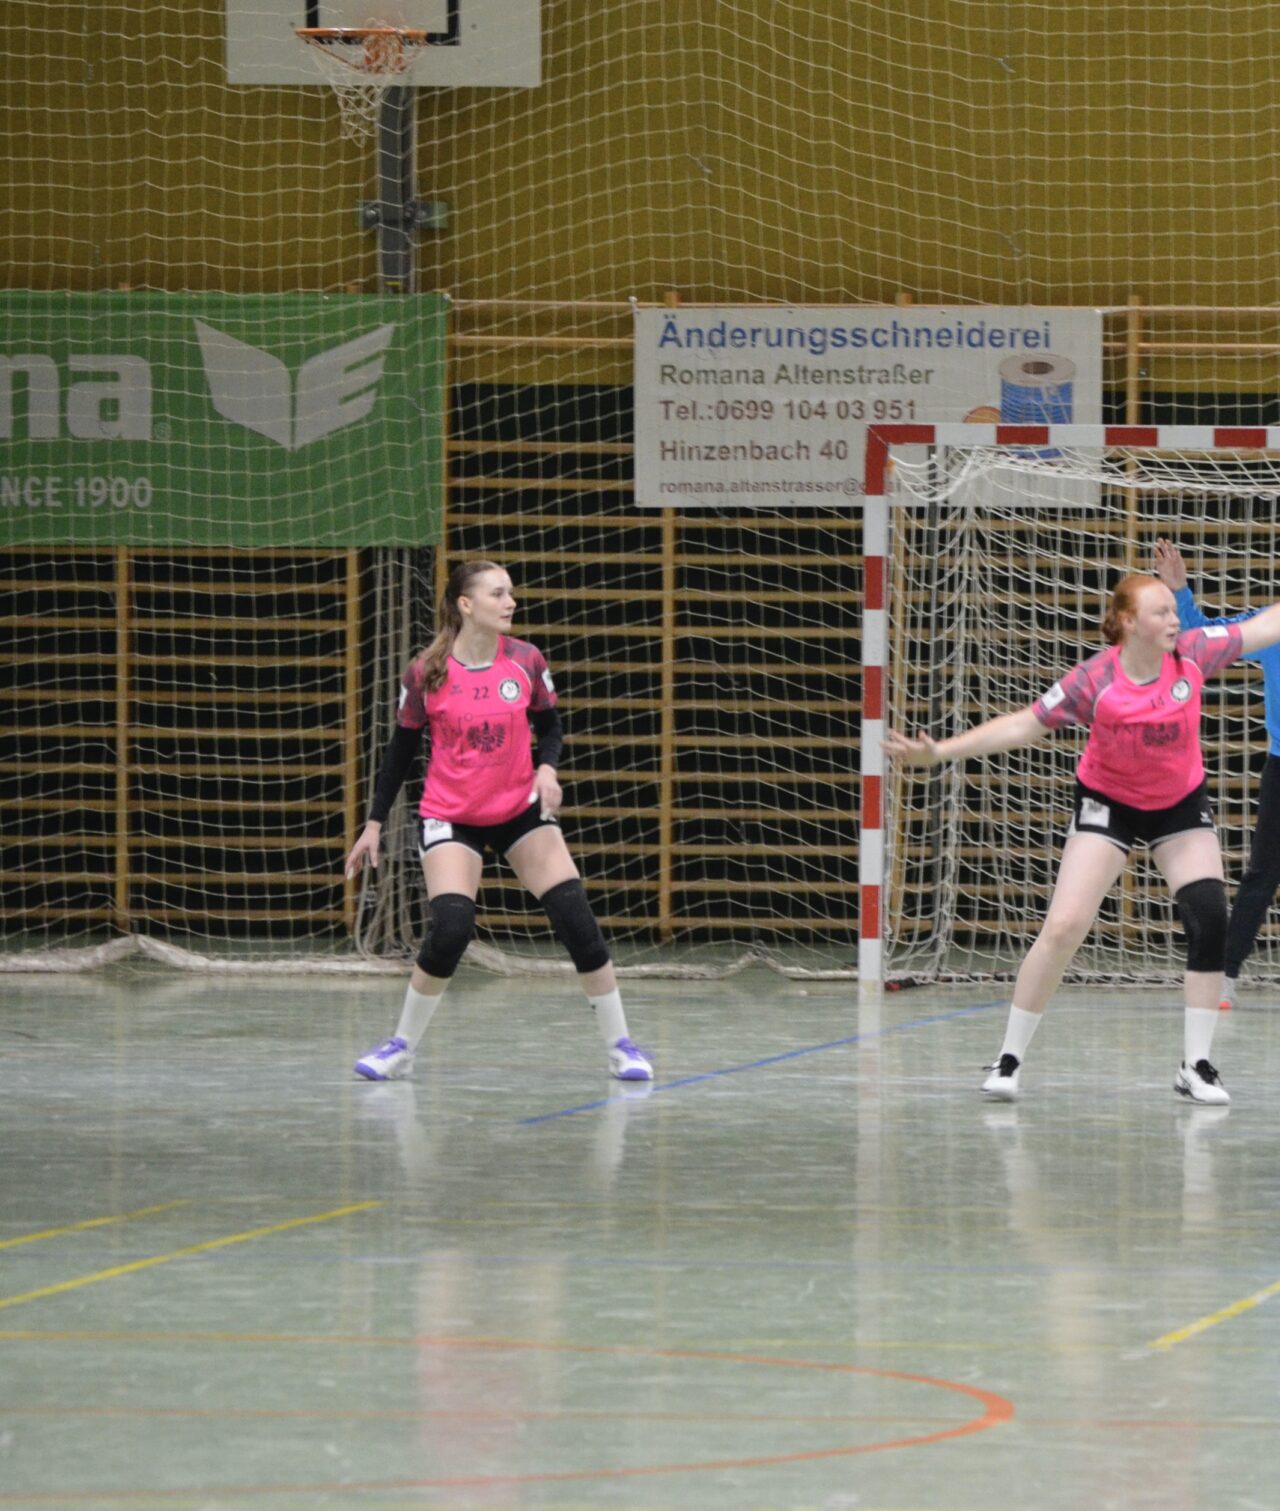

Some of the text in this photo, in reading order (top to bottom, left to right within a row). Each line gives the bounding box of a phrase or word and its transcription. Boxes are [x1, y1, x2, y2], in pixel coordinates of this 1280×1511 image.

[658, 314, 1051, 356] Änderungsschneiderei
[660, 363, 935, 386] Romana Altenstraßer
[659, 400, 916, 421] Tel.:0699 104 03 951
[660, 440, 849, 462] Hinzenbach 40
[74, 476, 153, 508] 1900
[473, 686, 490, 701] 22
